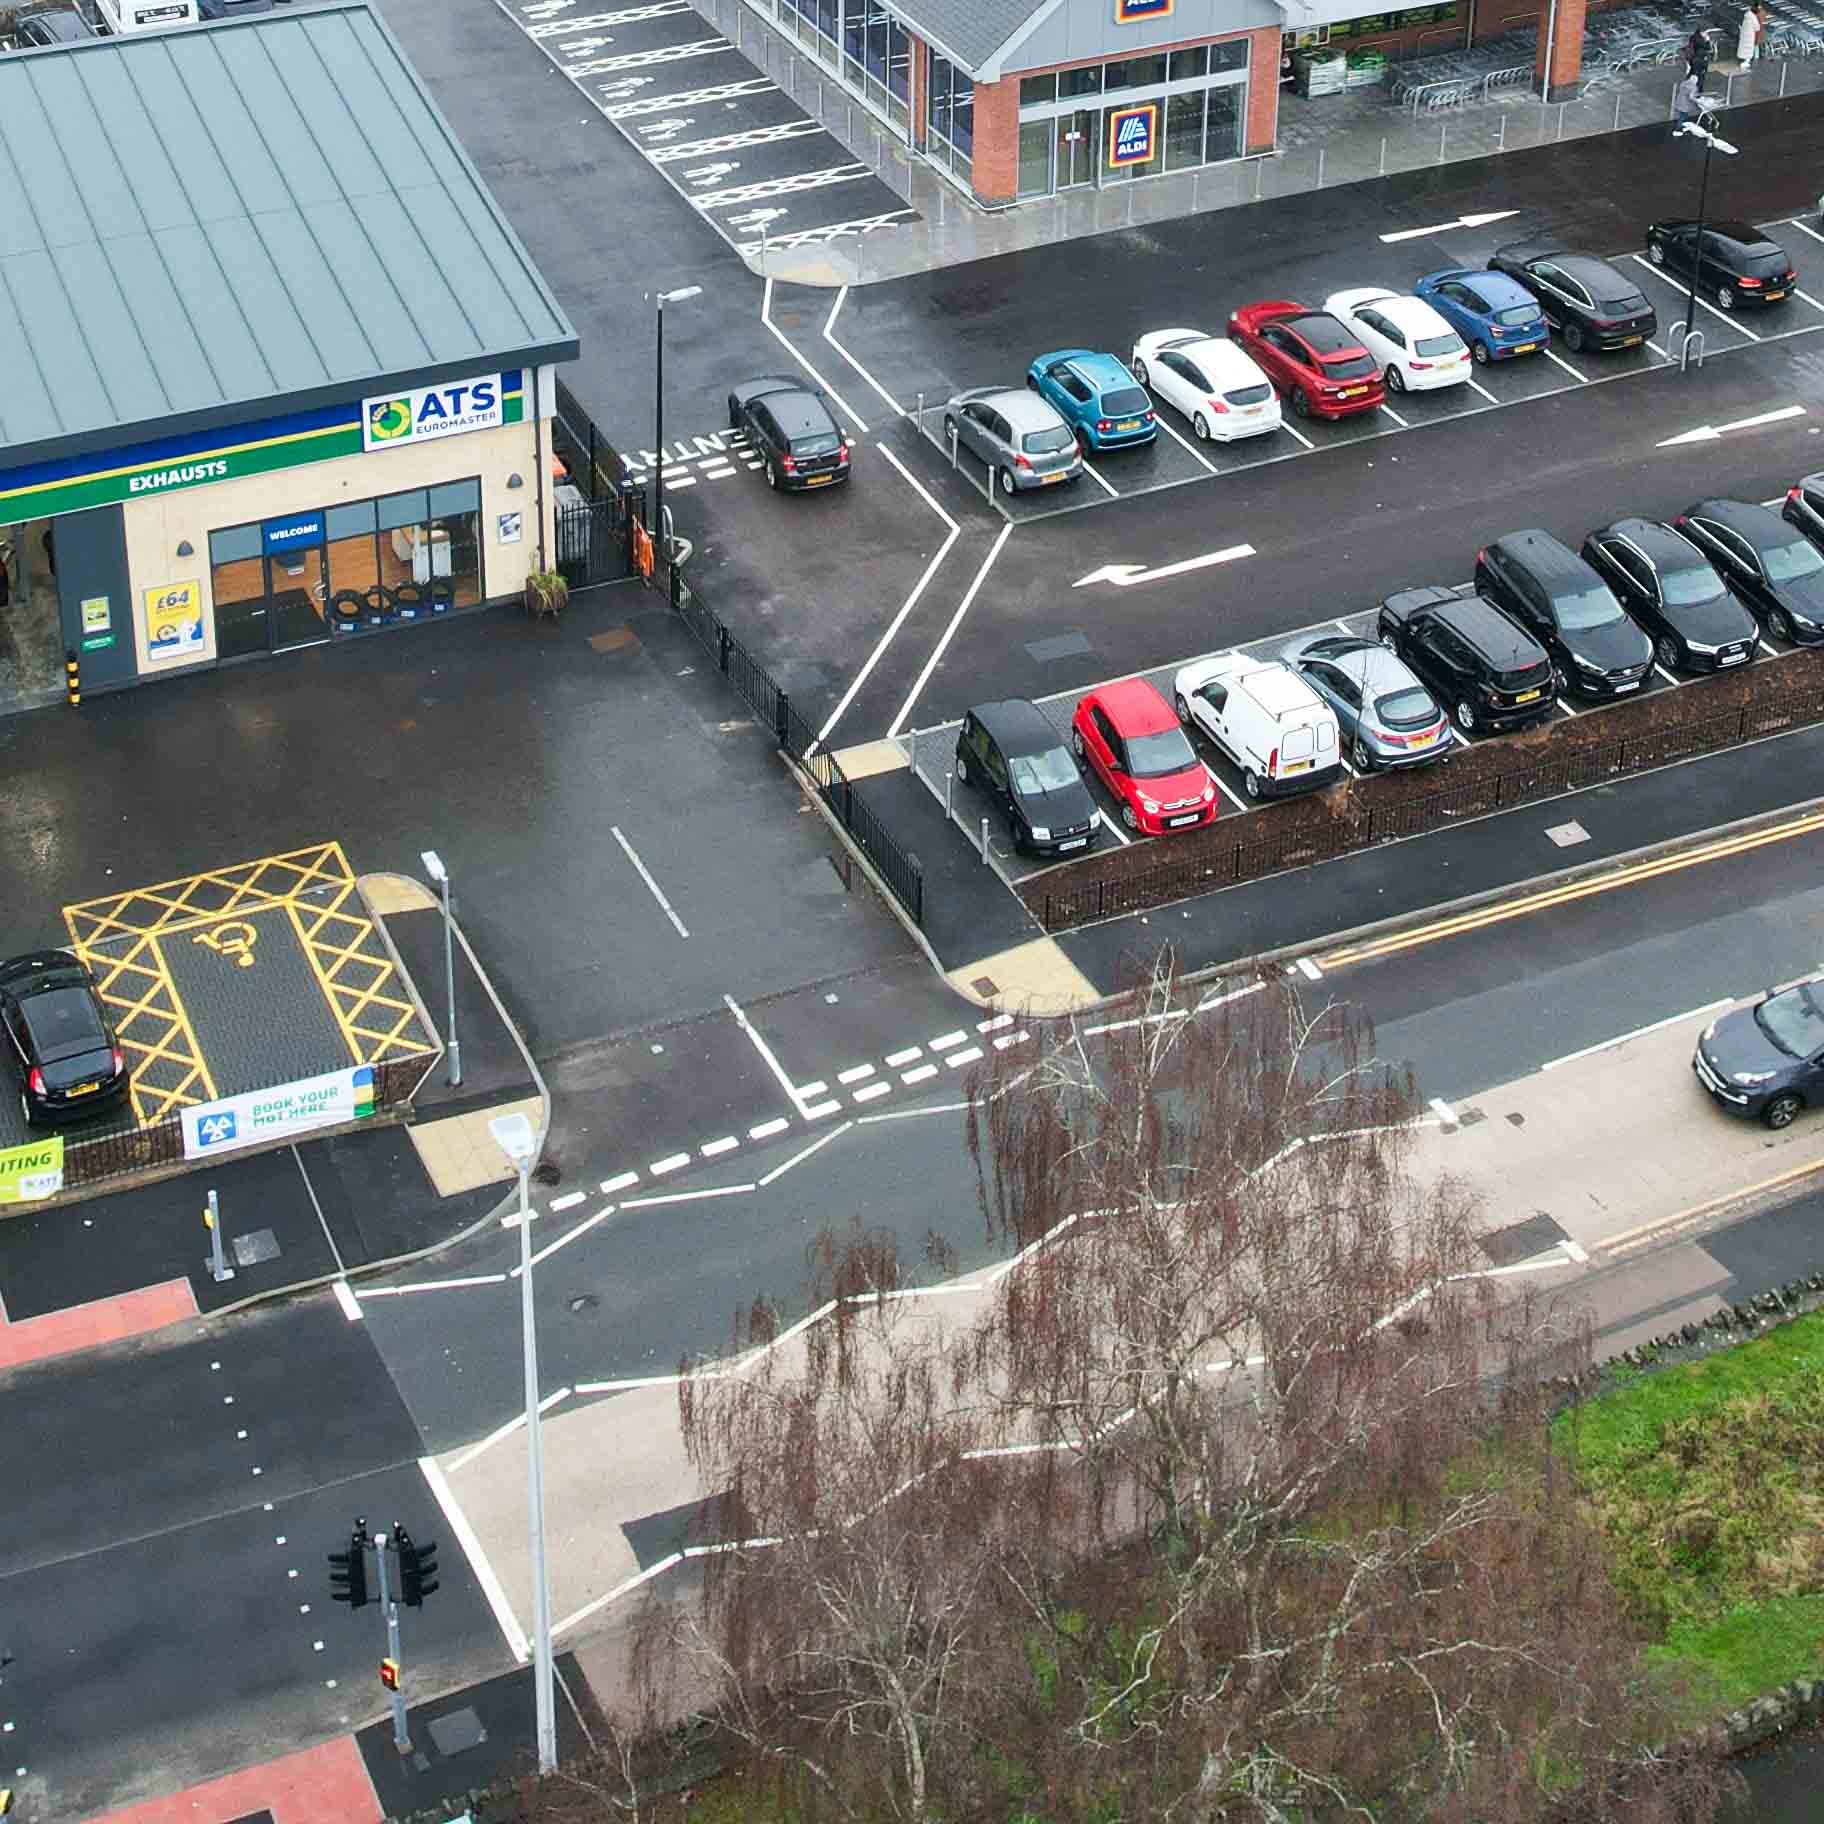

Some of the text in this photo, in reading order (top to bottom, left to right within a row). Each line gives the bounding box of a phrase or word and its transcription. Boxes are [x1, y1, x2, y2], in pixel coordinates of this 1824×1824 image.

[1118, 140, 1147, 155] ALDI
[417, 382, 496, 423] ATS
[416, 412, 496, 434] EUROMASTER
[129, 460, 228, 492] EXHAUSTS
[269, 523, 318, 541] WELCOME
[156, 589, 189, 609] £64
[252, 1087, 338, 1116] BOOK YOUR
[287, 1102, 329, 1120] HERE
